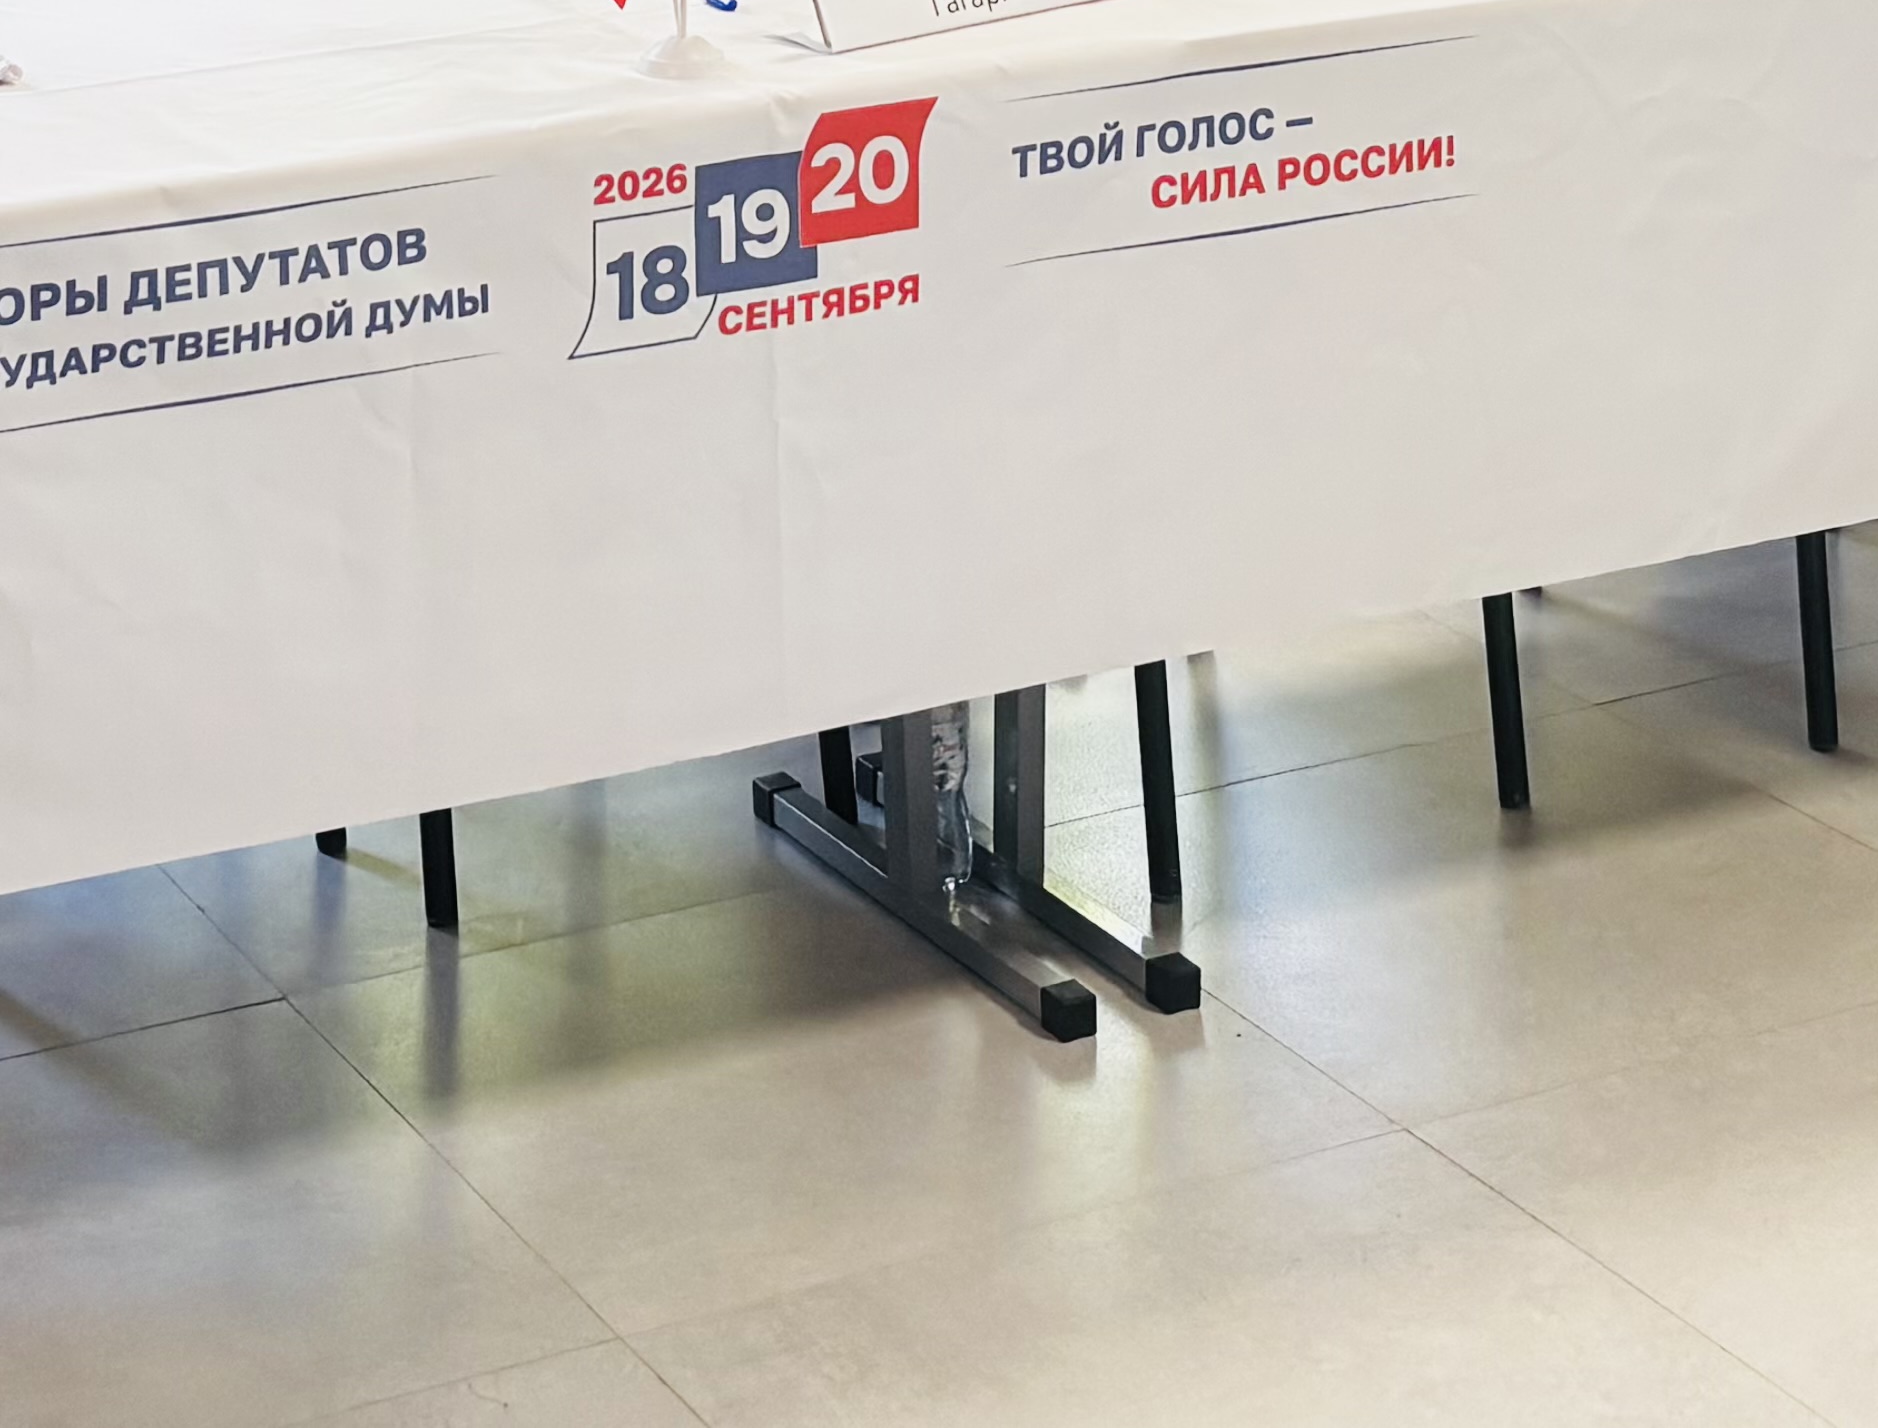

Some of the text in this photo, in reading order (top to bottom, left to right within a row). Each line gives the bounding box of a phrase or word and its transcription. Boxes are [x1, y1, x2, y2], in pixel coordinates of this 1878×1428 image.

[1011, 120, 1124, 178] ТВОЙ
[1135, 107, 1275, 158] ГОЛОС
[1151, 134, 1456, 209] СИЛА РОССИИ!
[593, 163, 688, 206] 2026
[606, 134, 910, 321] 18 19 20
[123, 227, 427, 315] ДЕПУТАТОВ
[717, 273, 920, 336] СЕНТЯБРЯ
[0, 283, 490, 390] УДАРСТВЕННОЙ ДУМЫ
